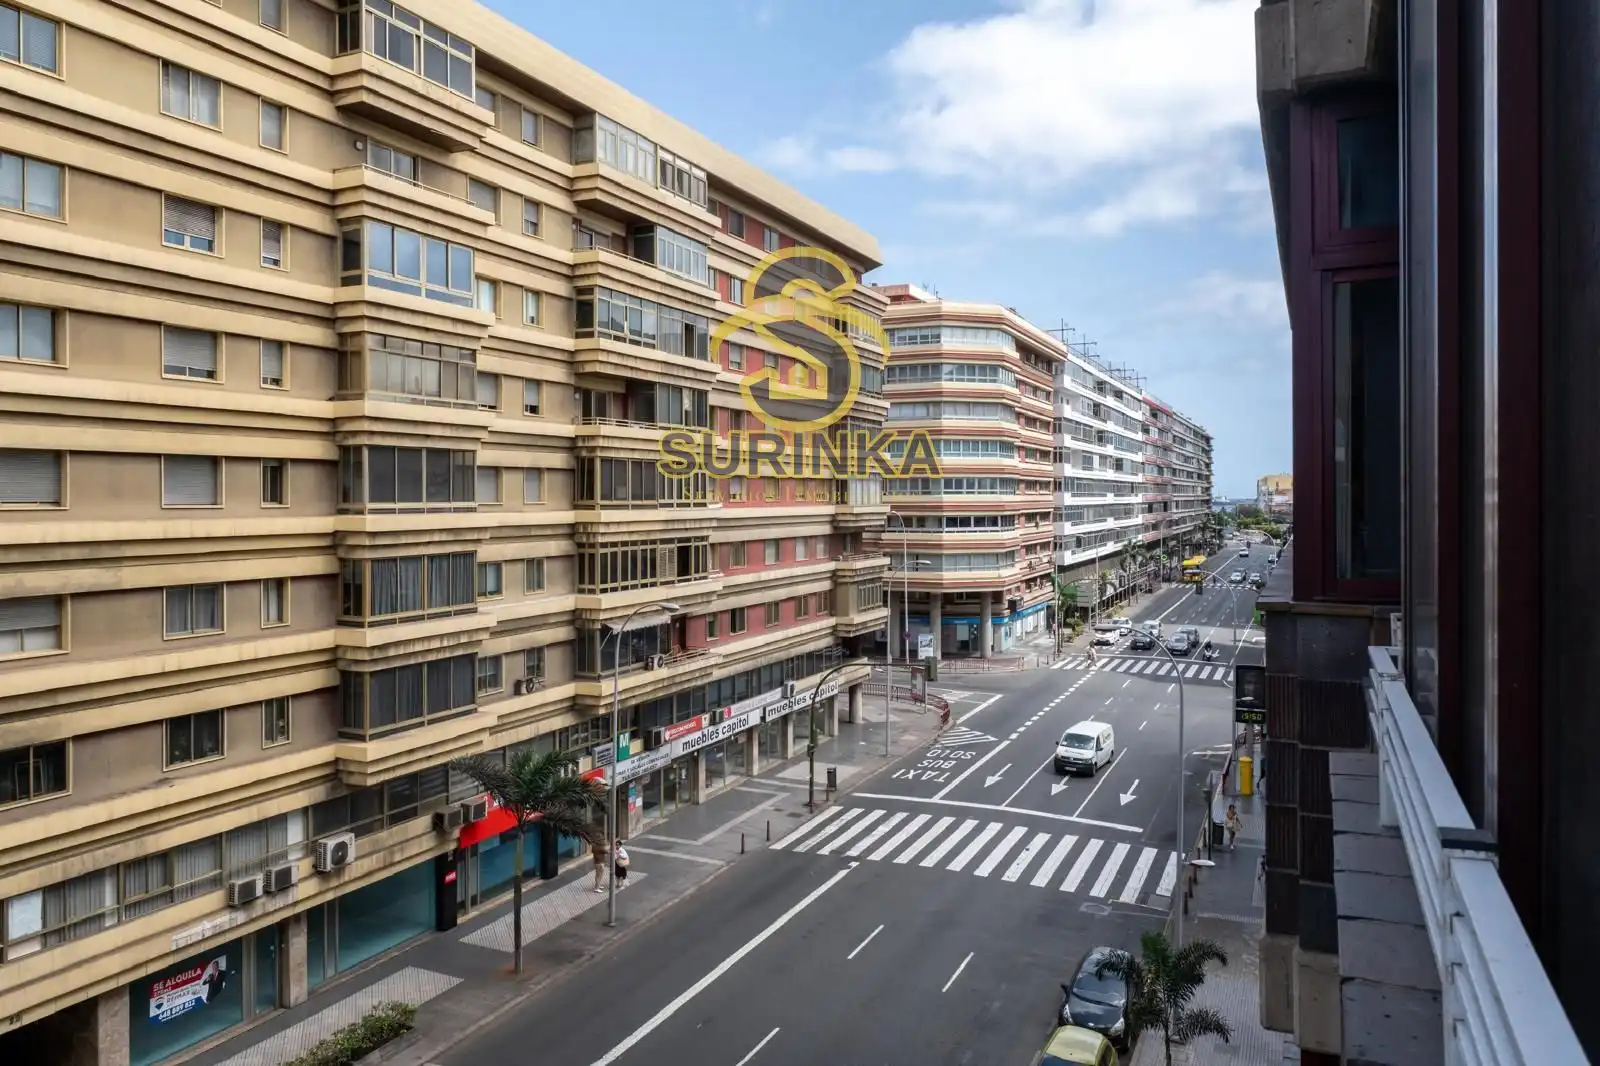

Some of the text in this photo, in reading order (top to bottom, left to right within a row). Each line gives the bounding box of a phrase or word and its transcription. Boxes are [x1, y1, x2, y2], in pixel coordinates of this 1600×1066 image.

[767, 695, 807, 716] muebles
[682, 728, 719, 752] muebles
[721, 714, 749, 735] capitol
[926, 749, 976, 759] SOLO
[917, 759, 957, 769] BUS
[891, 768, 951, 783] TAXI
[153, 980, 165, 992] SE
[165, 967, 202, 988] ALQUILA
